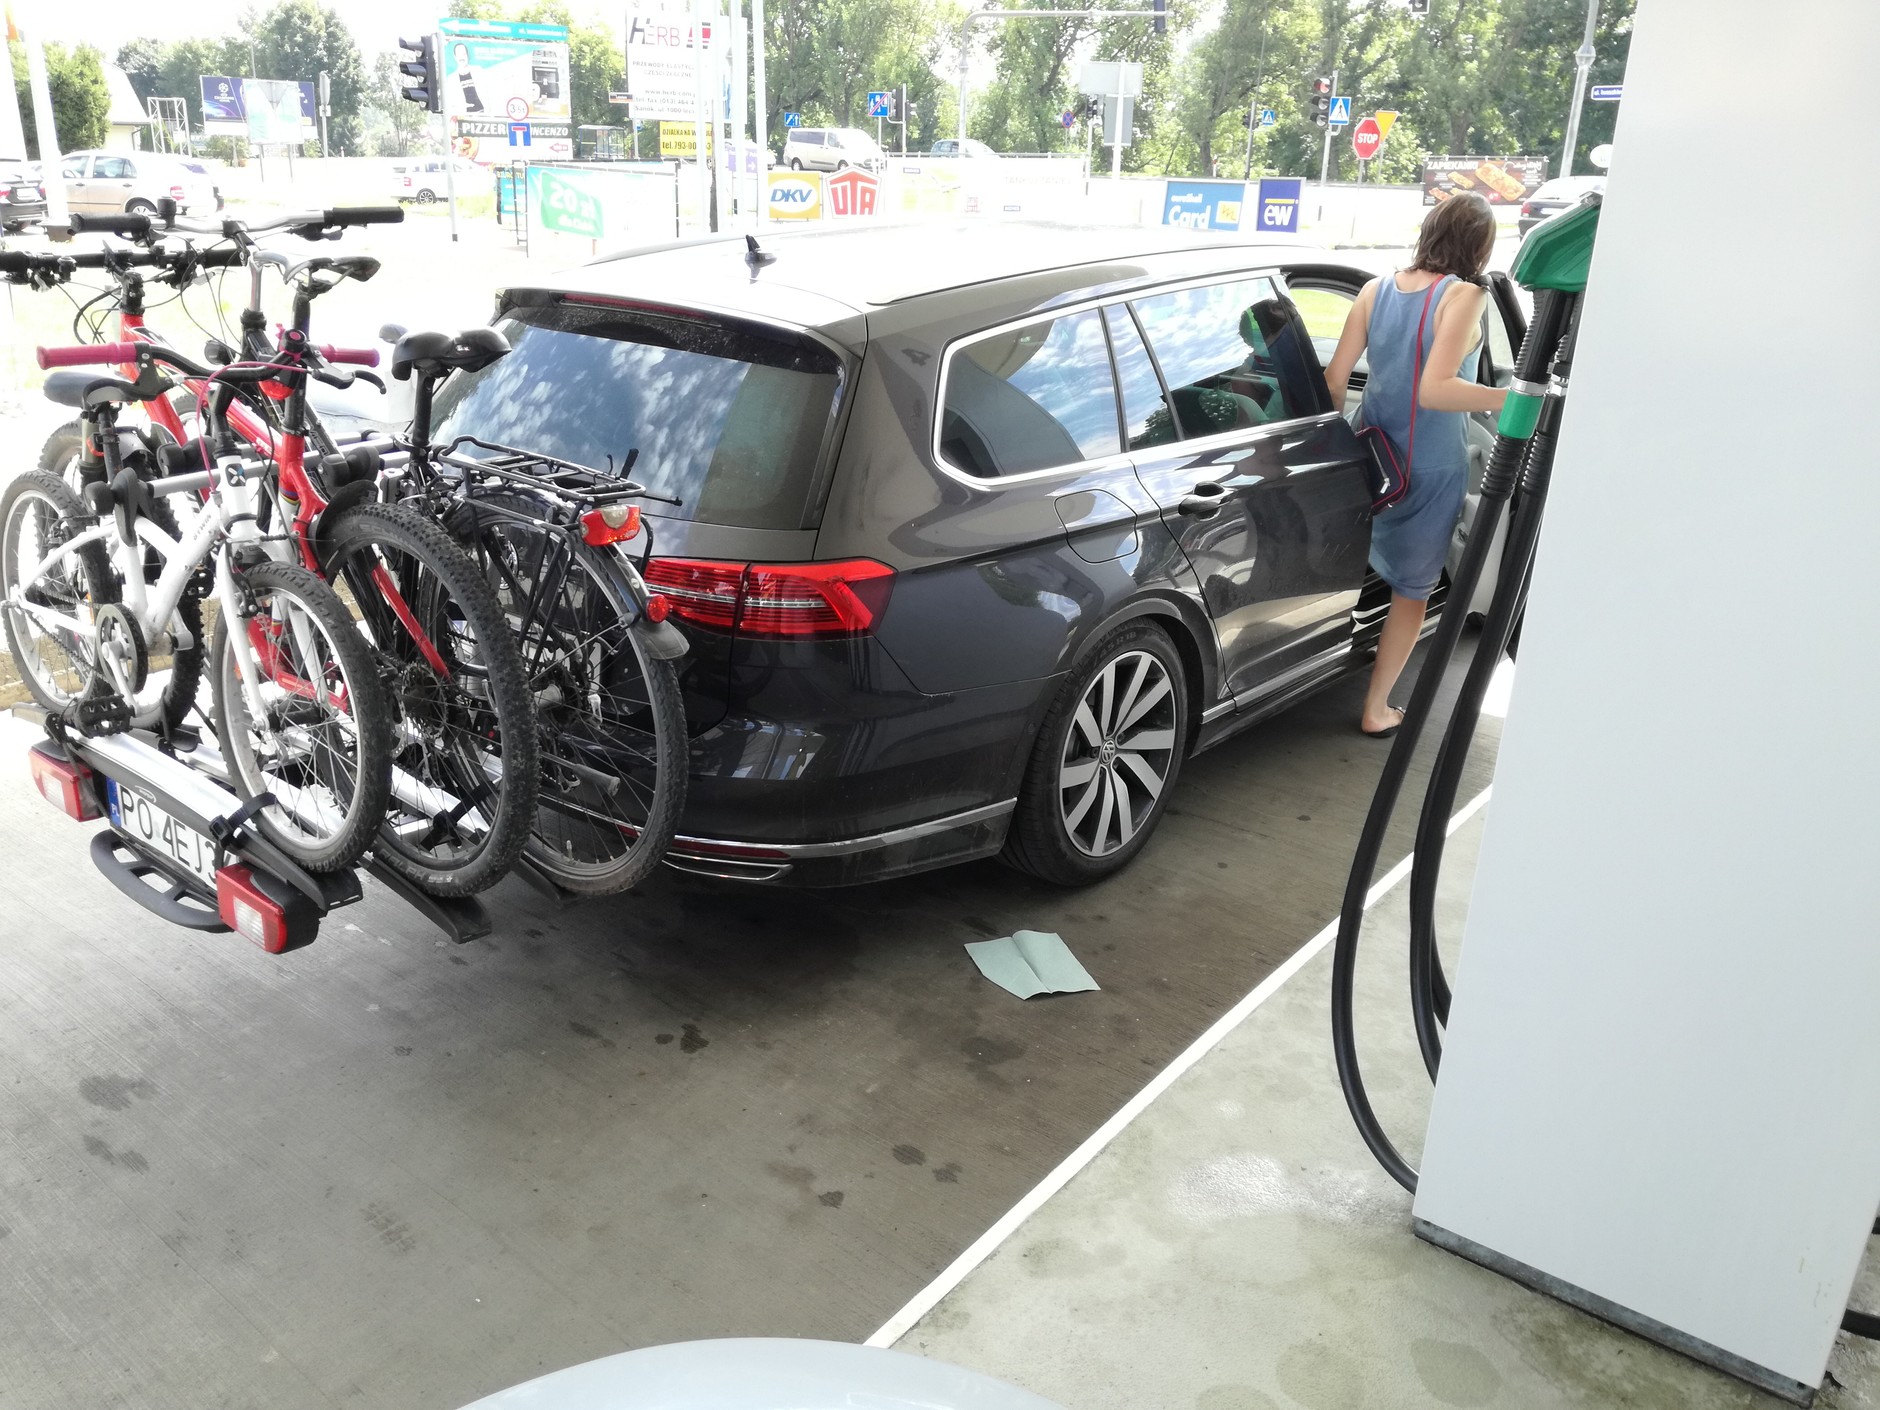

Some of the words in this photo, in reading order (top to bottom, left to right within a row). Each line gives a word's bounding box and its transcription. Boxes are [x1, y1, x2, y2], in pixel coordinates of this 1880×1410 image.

[462, 121, 508, 135] PIZZER
[1357, 132, 1379, 145] STOP
[550, 181, 577, 213] 20
[770, 188, 813, 203] DKV
[829, 170, 878, 216] UTA
[1168, 204, 1211, 230] Card
[1264, 204, 1293, 226] ew
[120, 784, 153, 840] PO
